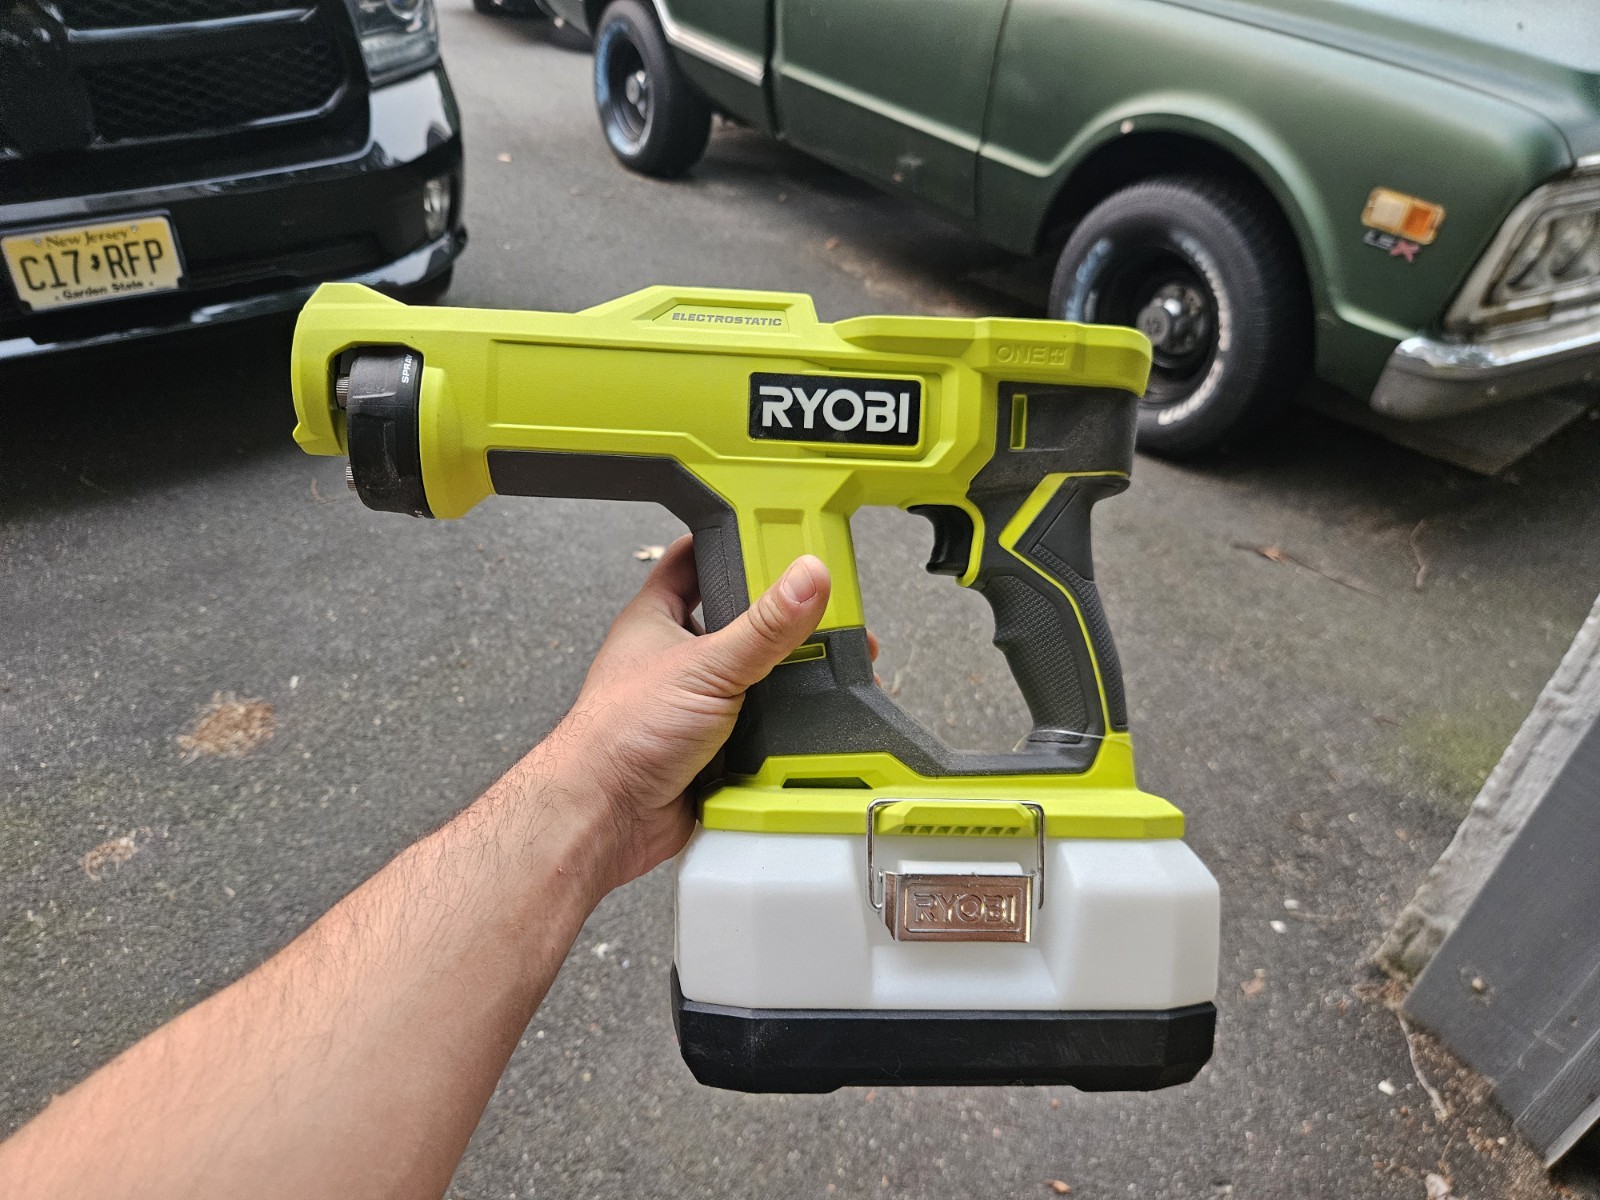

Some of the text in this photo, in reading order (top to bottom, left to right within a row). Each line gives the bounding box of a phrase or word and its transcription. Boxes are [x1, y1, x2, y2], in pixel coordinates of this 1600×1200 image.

[46, 230, 129, 248] New Jersey
[19, 239, 164, 291] C17 RFP
[63, 281, 144, 300] Garden State
[671, 312, 783, 327] ELECTROSTATIC
[401, 354, 413, 384] SPRAY
[759, 385, 910, 434] RYOBI
[913, 892, 1017, 924] RYOBI
